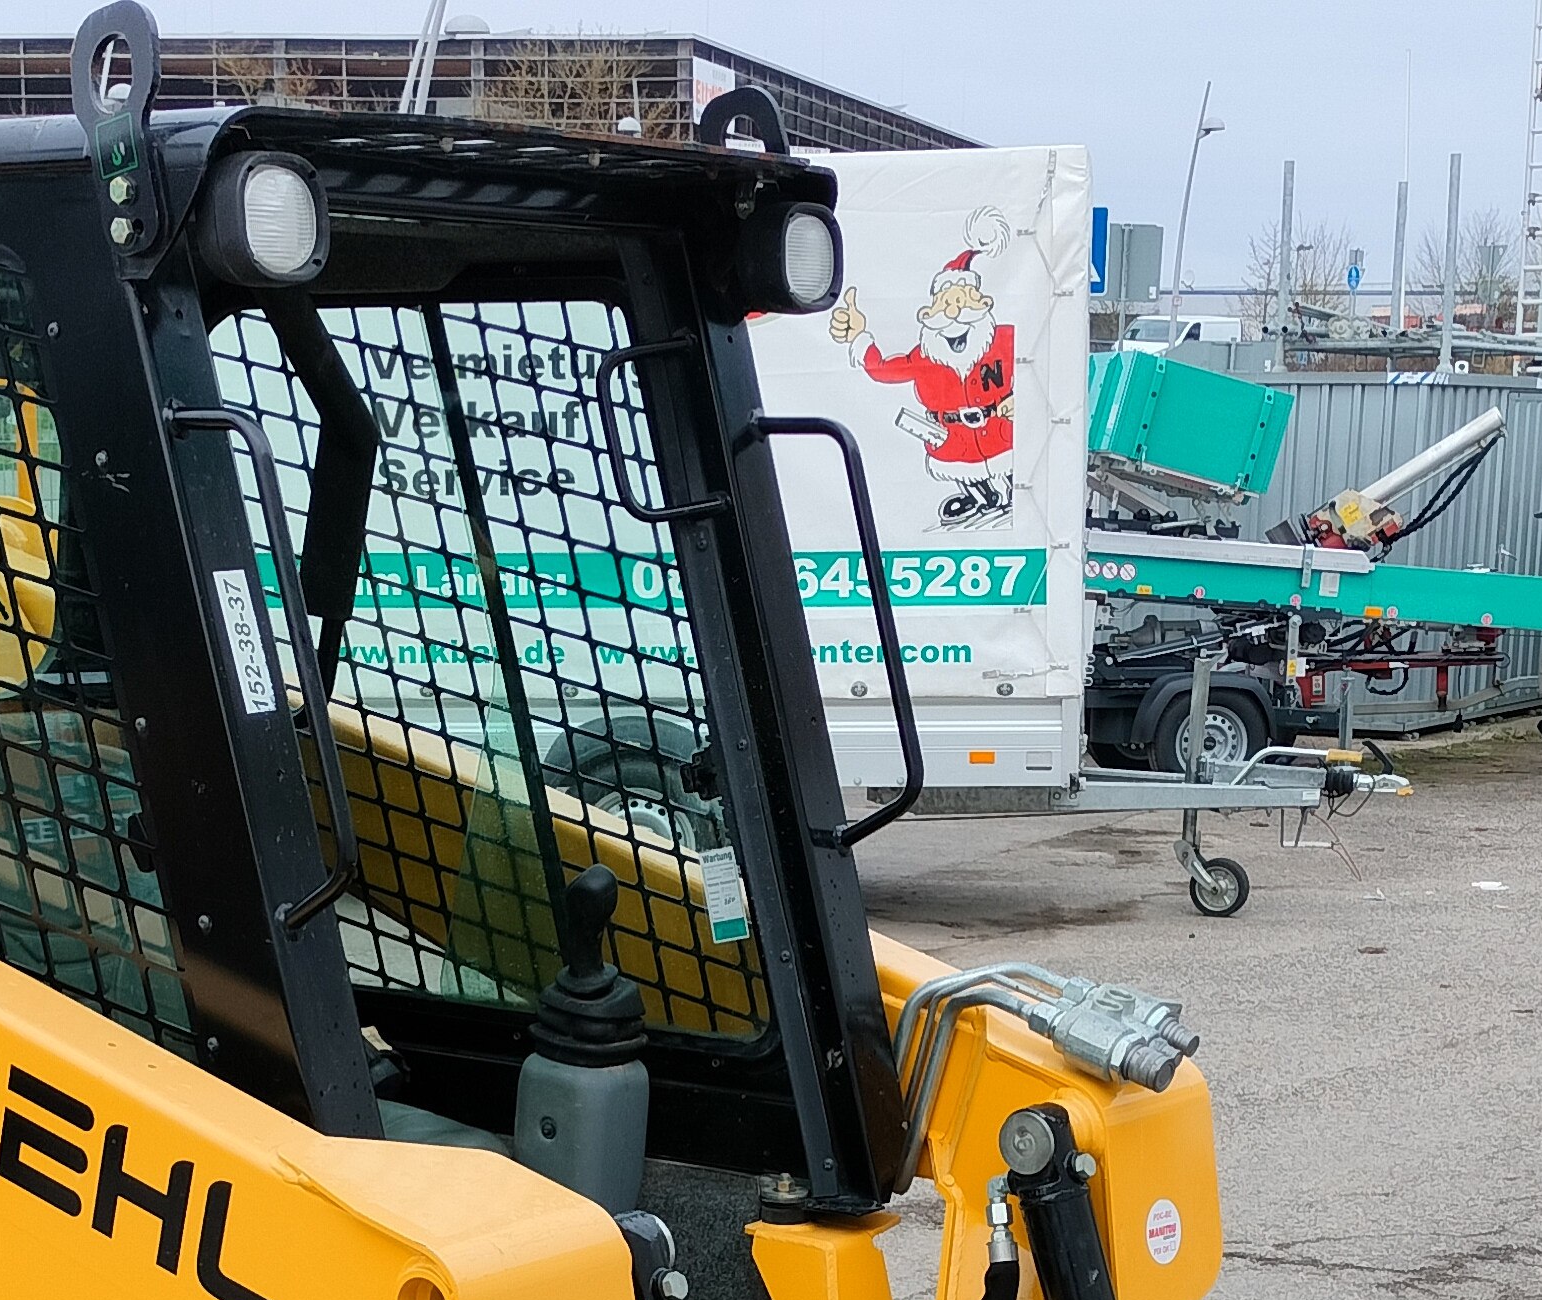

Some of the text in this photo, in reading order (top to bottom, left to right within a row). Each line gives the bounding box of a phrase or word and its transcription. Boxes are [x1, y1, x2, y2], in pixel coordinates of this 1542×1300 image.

[980, 360, 1005, 392] N
[222, 578, 269, 712] 152-38-37
[701, 850, 734, 865] Wartung
